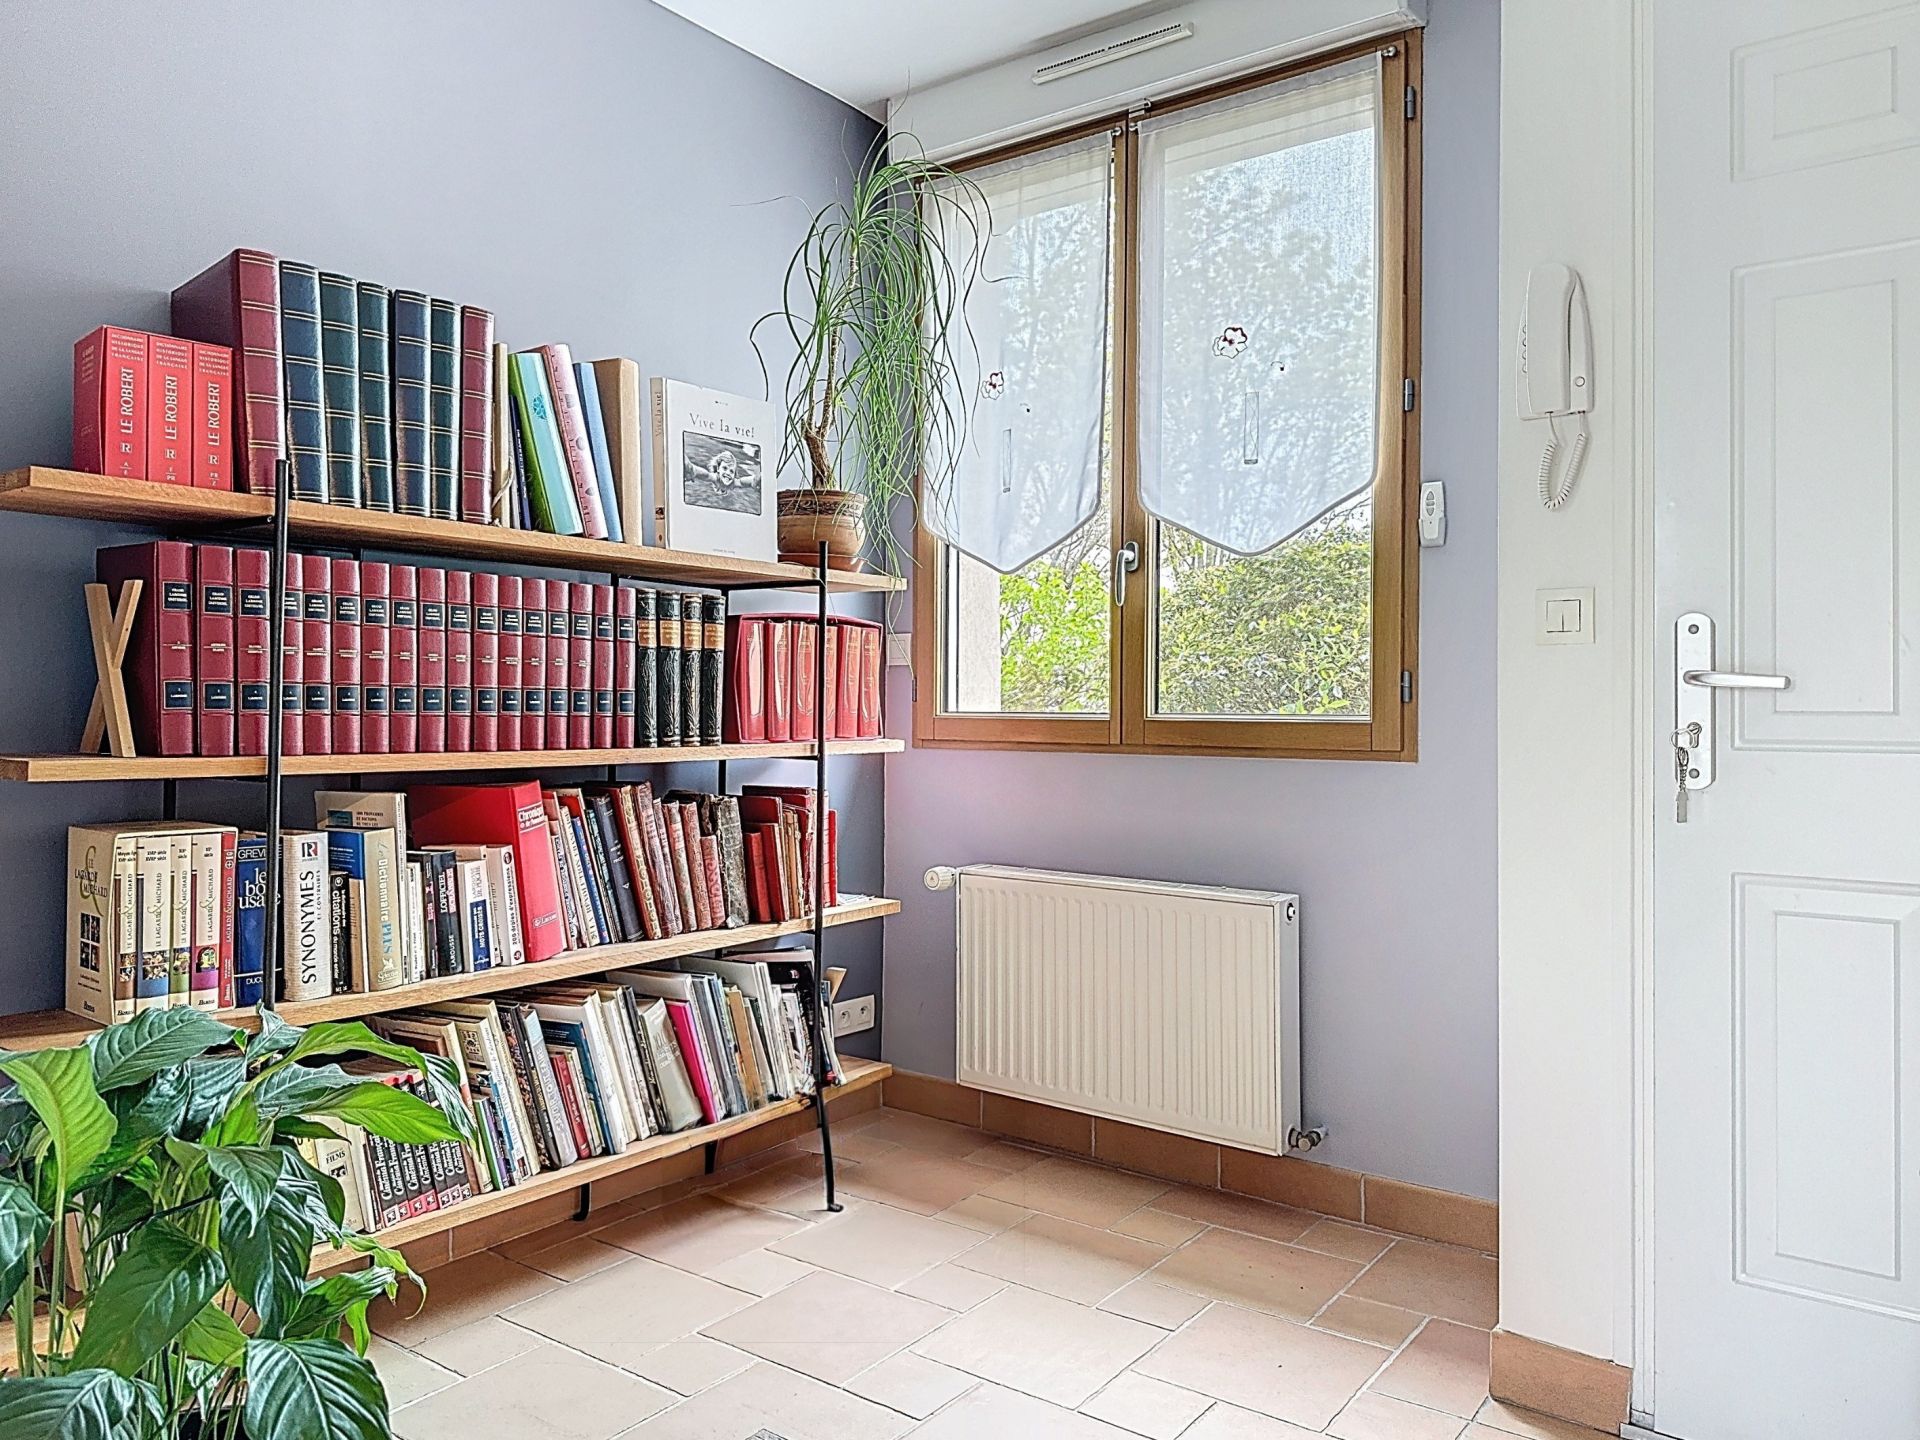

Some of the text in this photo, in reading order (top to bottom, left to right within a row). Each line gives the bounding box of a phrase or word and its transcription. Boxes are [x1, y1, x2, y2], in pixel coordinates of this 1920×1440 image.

[121, 366, 134, 434] LE ROBERT
[165, 374, 177, 440] LE ROBERT
[208, 381, 219, 445] LE ROBERT
[690, 412, 755, 438] Vive la vie!
[254, 867, 267, 884] le
[379, 859, 389, 922] Dictionnaire
[300, 870, 317, 984] SYNONYMES
[536, 1048, 564, 1128] SAVOIR TOUT FAIRE
[326, 1150, 346, 1164] FILMS
[374, 1134, 392, 1200] Cinéma Françai
[420, 1155, 430, 1184] Cinéma
[433, 1152, 444, 1180] Cinéma
[443, 1147, 454, 1176] Cinéma
[455, 1145, 465, 1174] Cinéma
[393, 1166, 404, 1195] Cinéma
[406, 1158, 419, 1190] Cinéma
